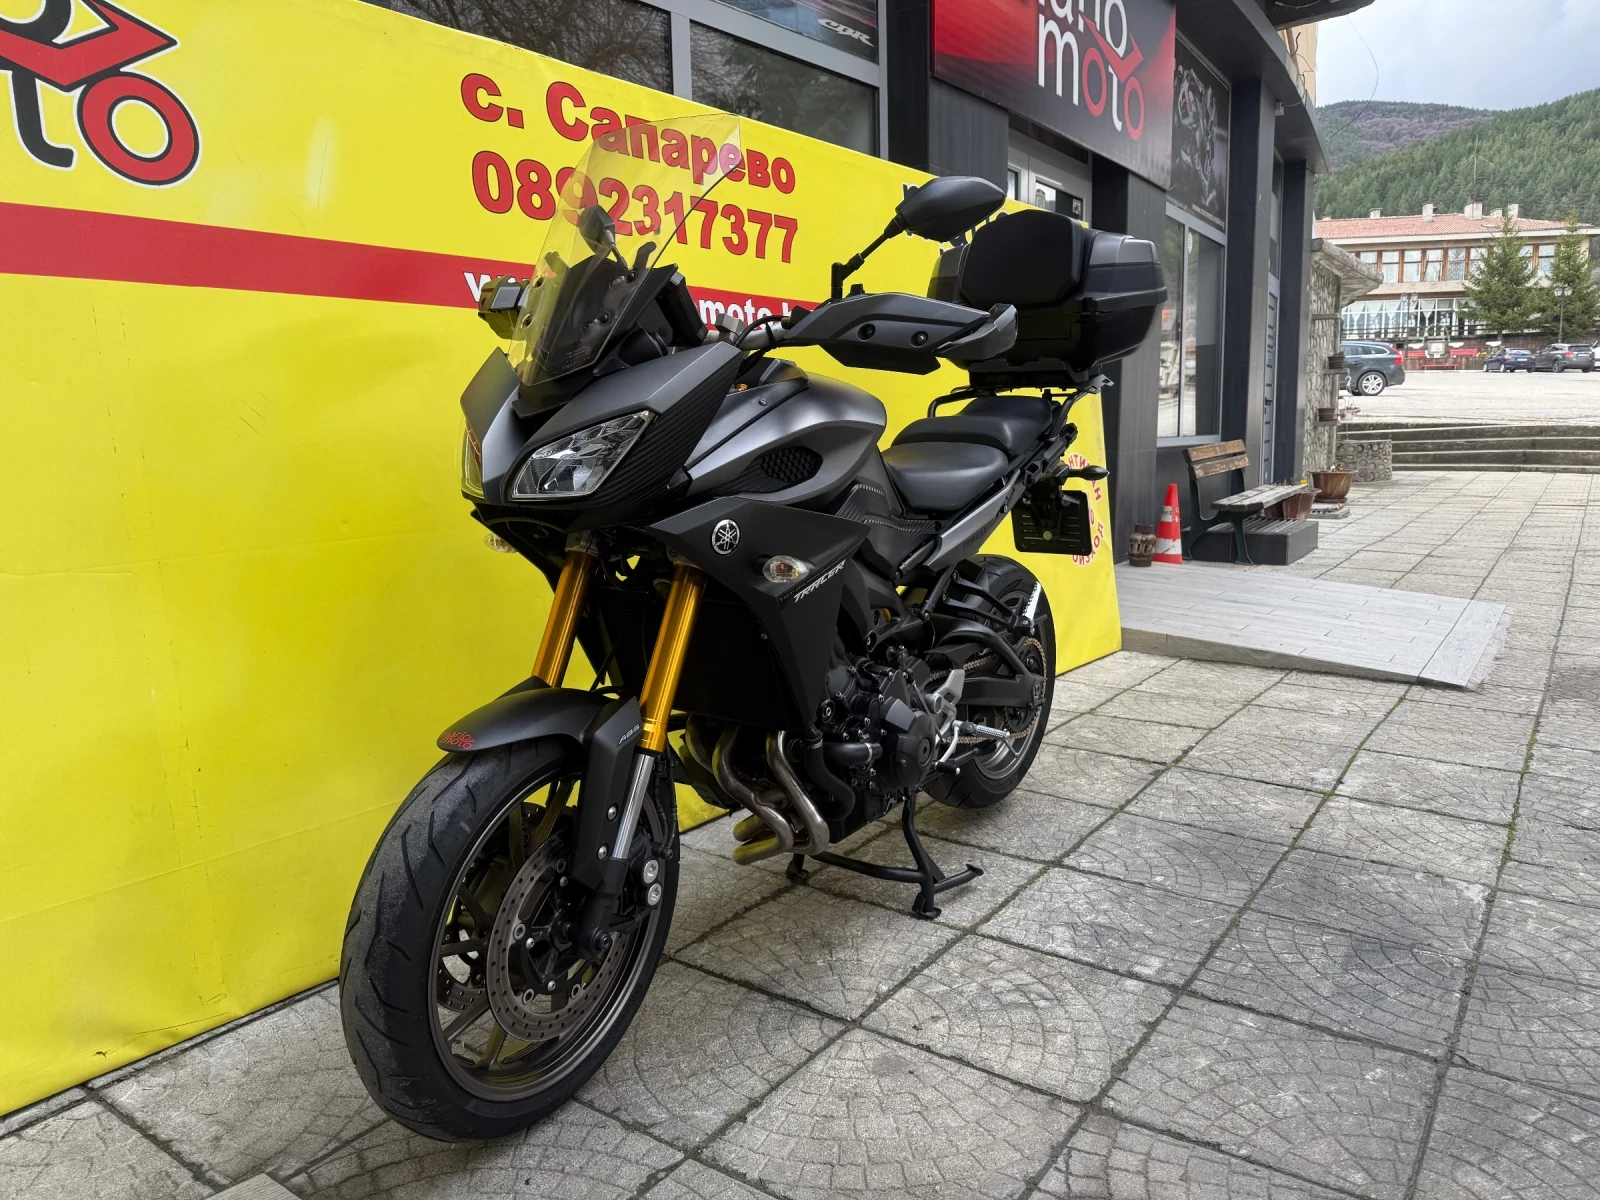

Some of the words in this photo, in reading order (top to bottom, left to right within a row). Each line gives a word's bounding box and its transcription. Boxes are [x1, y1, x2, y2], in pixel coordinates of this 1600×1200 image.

[460, 72, 525, 130] с.
[545, 81, 796, 195] Сапарево
[1038, 13, 1145, 141] moto
[471, 150, 798, 264] 0892317377
[793, 559, 847, 603] TRACER
